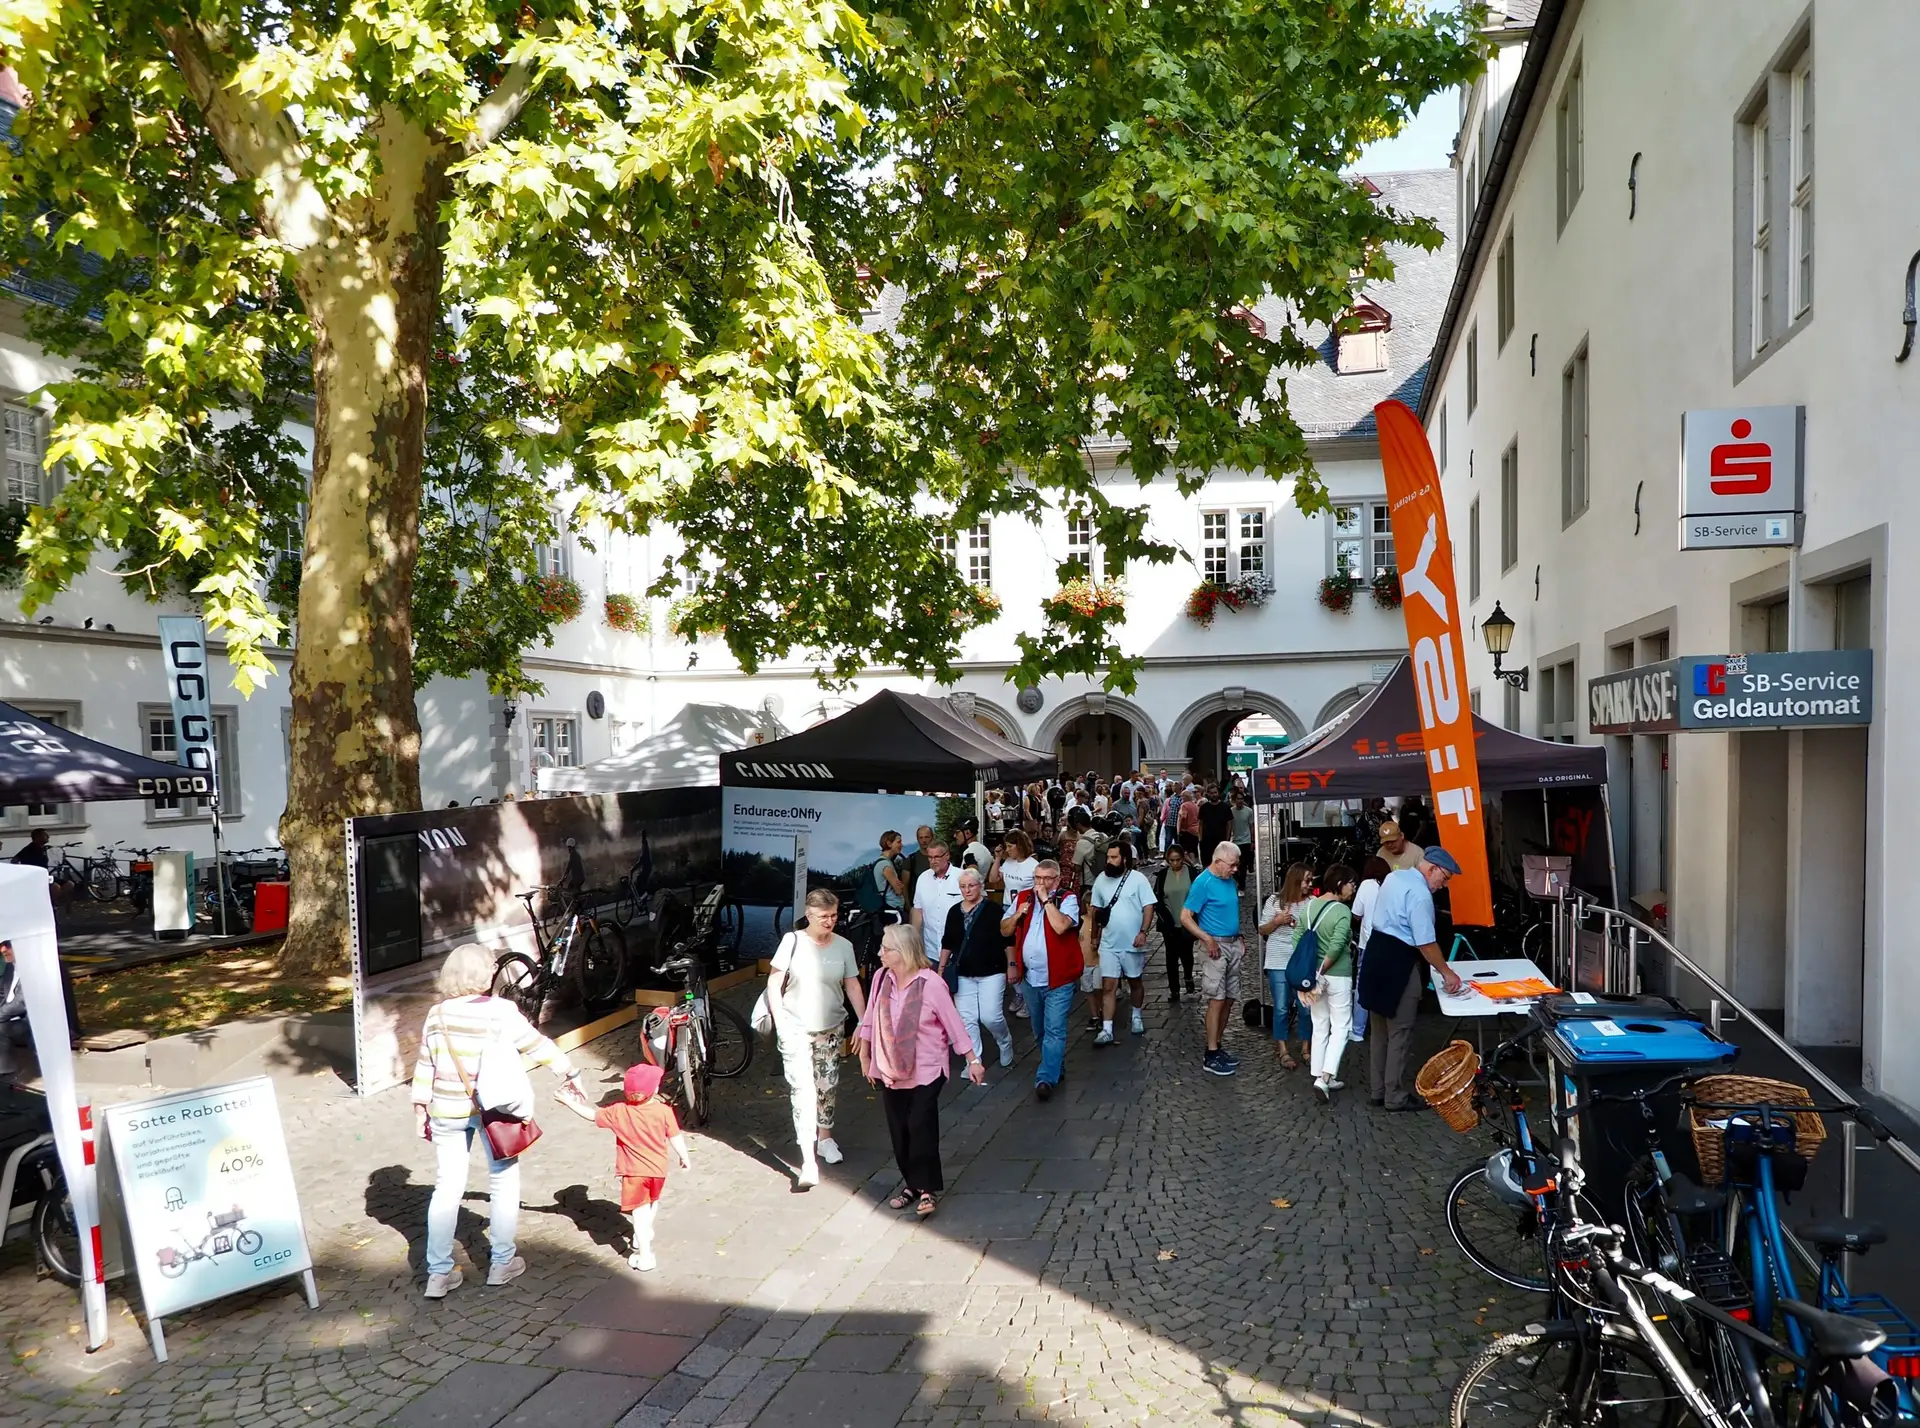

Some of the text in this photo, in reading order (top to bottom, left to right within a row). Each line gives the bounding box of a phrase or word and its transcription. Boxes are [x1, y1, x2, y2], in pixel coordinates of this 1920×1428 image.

[1693, 524, 1758, 538] SB-Service
[1742, 671, 1860, 693] SB-Service
[1591, 670, 1672, 726] SPARKASSE
[1692, 695, 1861, 720] Geldautomat
[735, 761, 834, 779] CANYON
[975, 767, 999, 783] CANYON
[1555, 773, 1593, 782] ORIGINAL.
[733, 804, 822, 822] Endurace:ONfly
[419, 826, 467, 852] YON
[128, 1095, 252, 1132] Satte Rabatte!
[224, 1145, 239, 1155] bis
[137, 1160, 153, 1170] und
[220, 1153, 264, 1174] 40%
